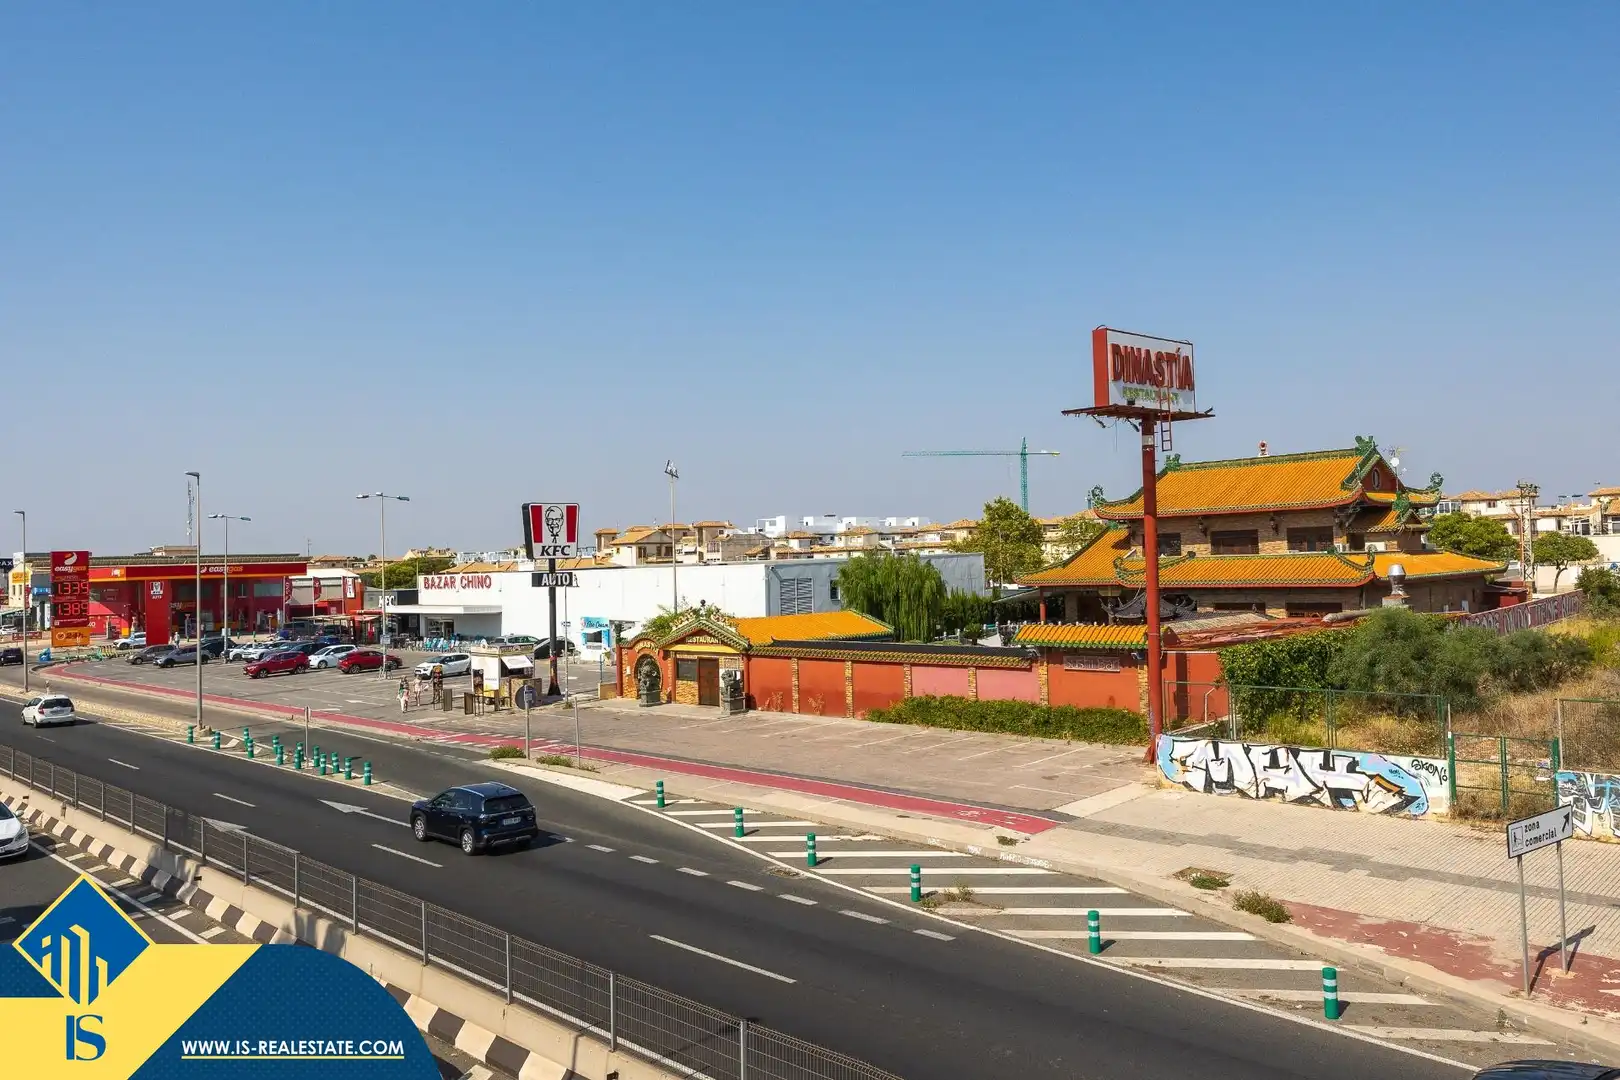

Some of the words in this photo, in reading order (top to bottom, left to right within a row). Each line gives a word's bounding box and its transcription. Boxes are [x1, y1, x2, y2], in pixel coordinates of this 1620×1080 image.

[1109, 343, 1194, 391] DINASTÍA
[540, 545, 570, 557] KFC
[423, 577, 456, 590] BAZAR
[460, 575, 492, 590] CHINO
[541, 573, 570, 587] AUTO
[1524, 820, 1540, 833] zona
[1525, 828, 1557, 848] comercial
